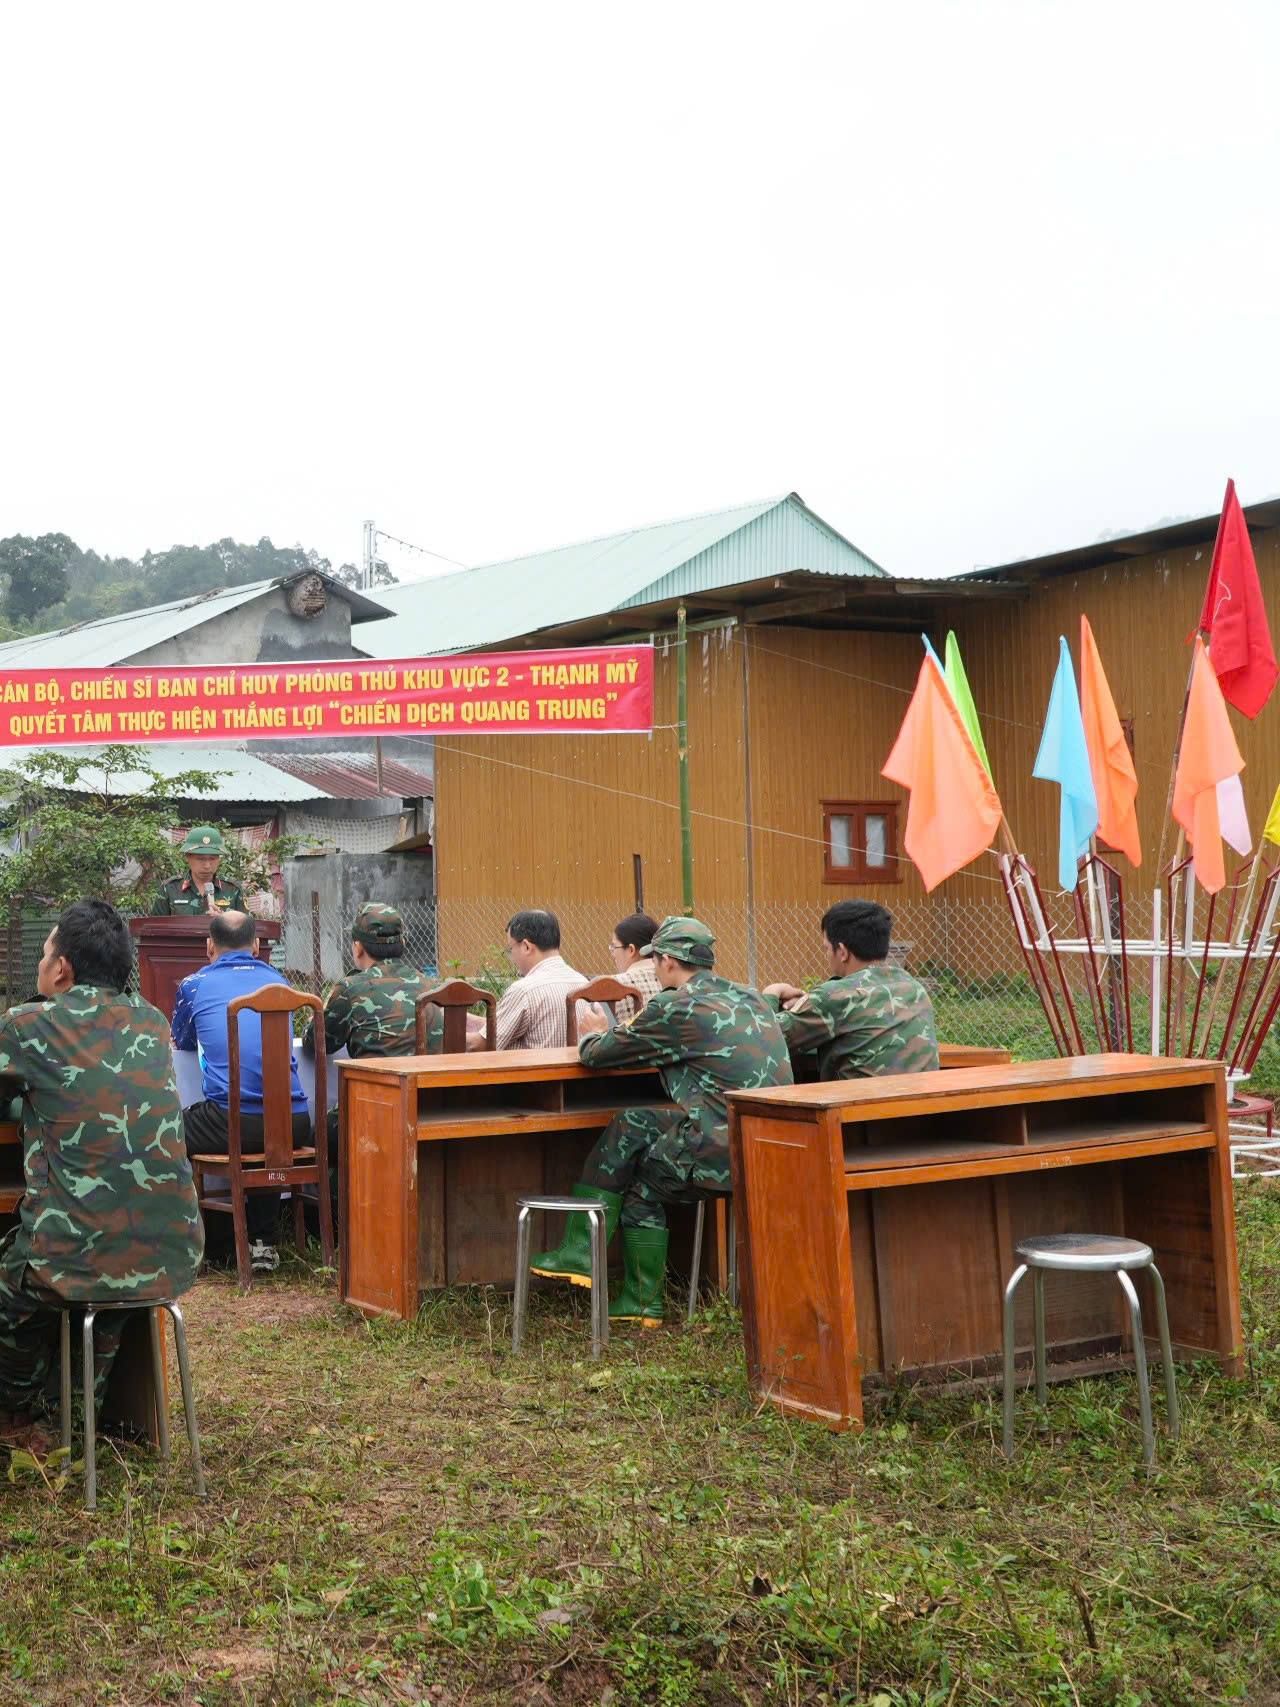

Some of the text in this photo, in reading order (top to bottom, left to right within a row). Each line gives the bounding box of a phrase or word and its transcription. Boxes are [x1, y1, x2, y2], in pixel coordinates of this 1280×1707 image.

[35, 678, 64, 705] BỘ,
[70, 674, 127, 701] CHIẾN
[133, 675, 153, 699] SĨ
[157, 677, 196, 698] BAN
[203, 669, 235, 696] CHỈ
[241, 675, 279, 695] HUY
[285, 665, 353, 694] PHÒNG
[359, 665, 397, 691] THỦ
[403, 670, 443, 690] KHU
[450, 667, 490, 692] VỰC
[496, 666, 509, 687] 2
[530, 664, 599, 690] THẠNH
[606, 658, 638, 684] MỸ
[9, 709, 66, 737] QUYẾT
[72, 709, 112, 733] TÂM
[118, 709, 166, 736] THỰC
[171, 706, 216, 733] HIỆN
[222, 701, 287, 729] THẮNG
[292, 703, 323, 731] LỢI
[407, 702, 455, 727] DỊCH
[460, 700, 530, 724] QUANG
